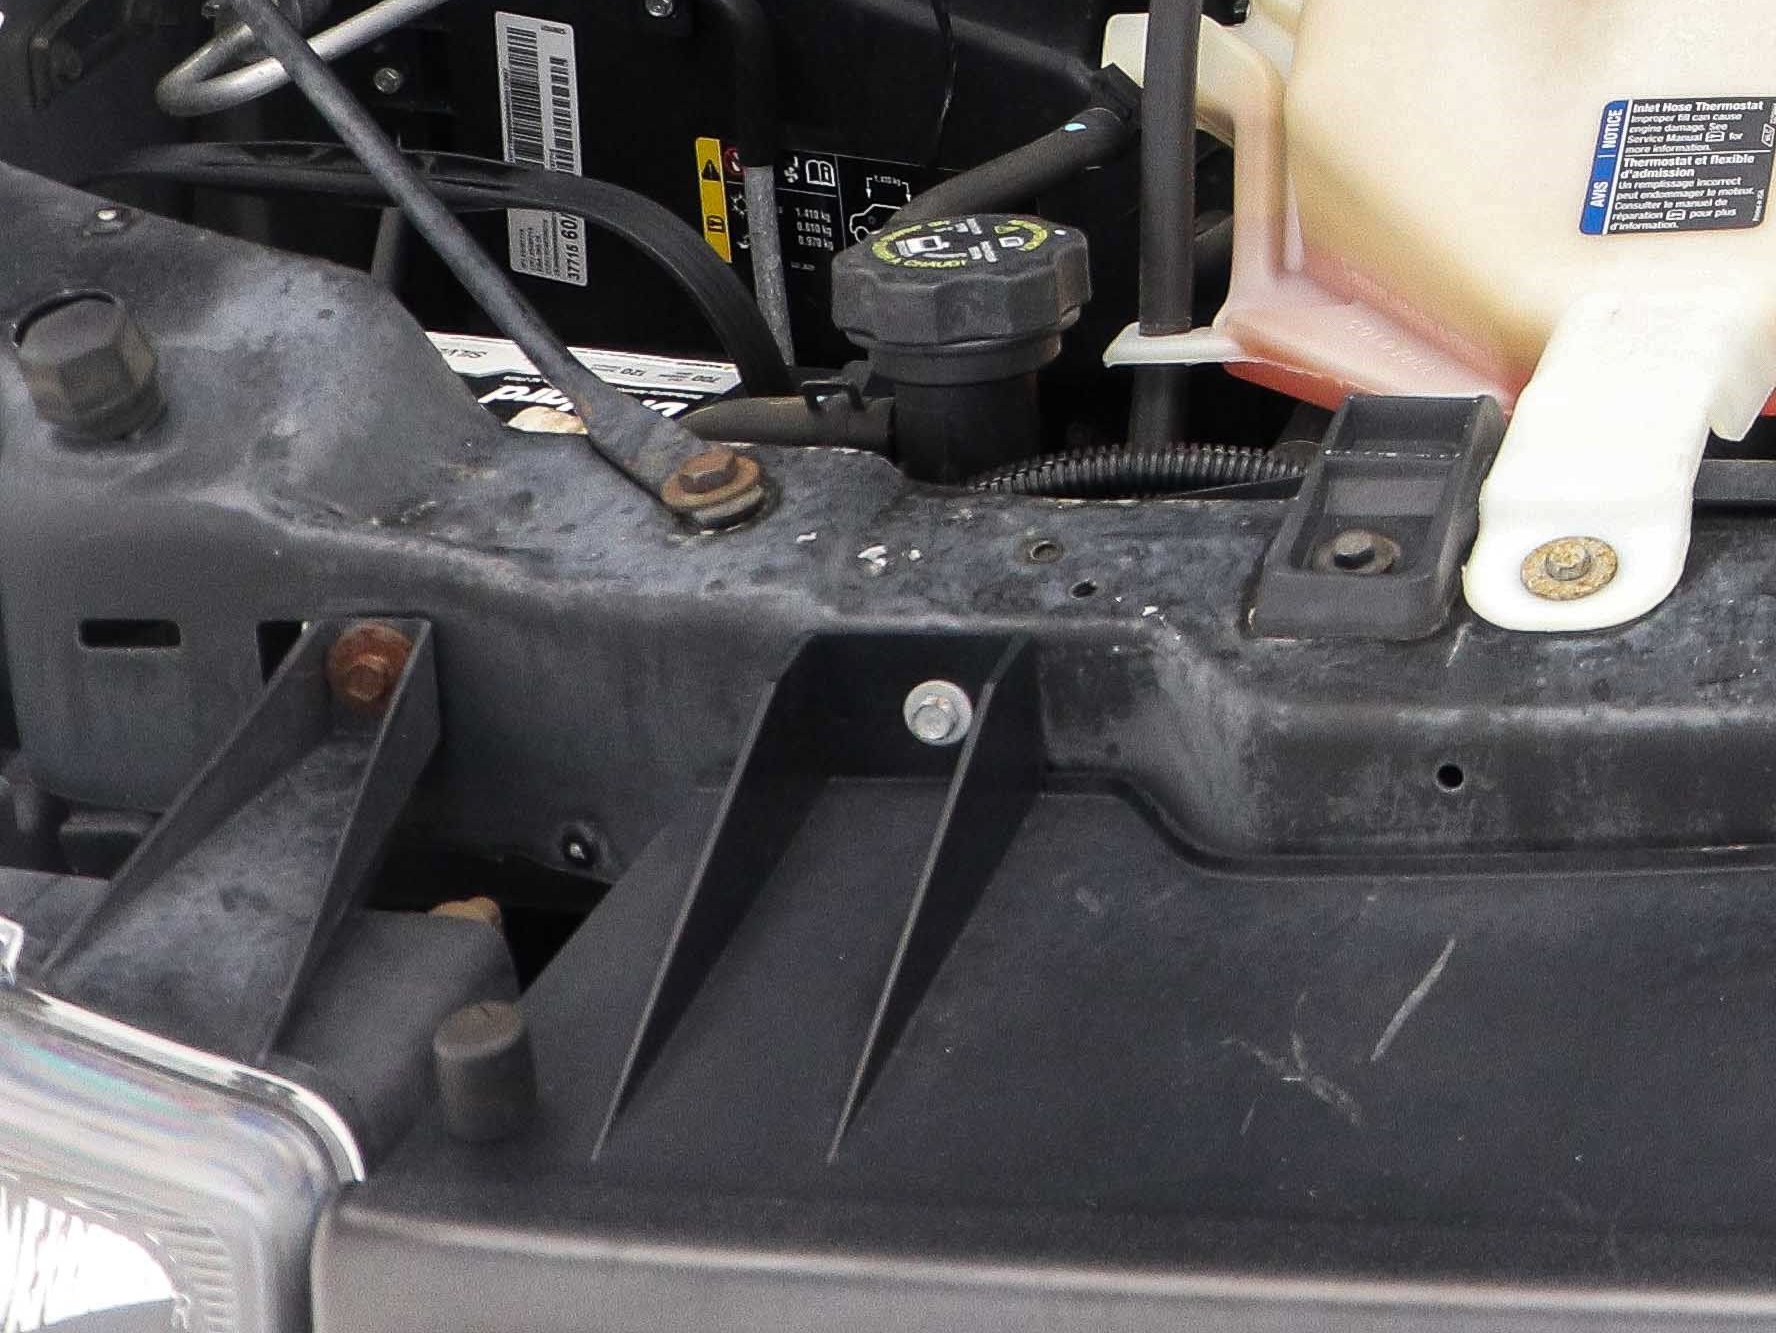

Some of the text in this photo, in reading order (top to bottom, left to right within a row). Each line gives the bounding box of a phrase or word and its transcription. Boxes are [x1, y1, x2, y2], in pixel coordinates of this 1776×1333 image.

[1633, 101, 1765, 113] Inlet Hose Thermostat
[1630, 113, 1743, 124] Improper fill can cause
[1601, 107, 1623, 149] NOTICE
[1628, 124, 1663, 134] engine
[1708, 122, 1729, 131] See
[1626, 132, 1743, 144] Service Manual for
[1624, 144, 1712, 154] more information.
[1622, 153, 1755, 168] Thermostat et flexible
[1618, 177, 1742, 191] Un remplissage incorrect
[1589, 180, 1609, 209] AVIS
[1616, 190, 1639, 201] peut
[1639, 189, 1705, 200] endommager
[1706, 188, 1717, 197] le
[1613, 197, 1728, 211] Consulter le manuel de
[1688, 210, 1714, 220] pour
[1714, 207, 1737, 217] plus
